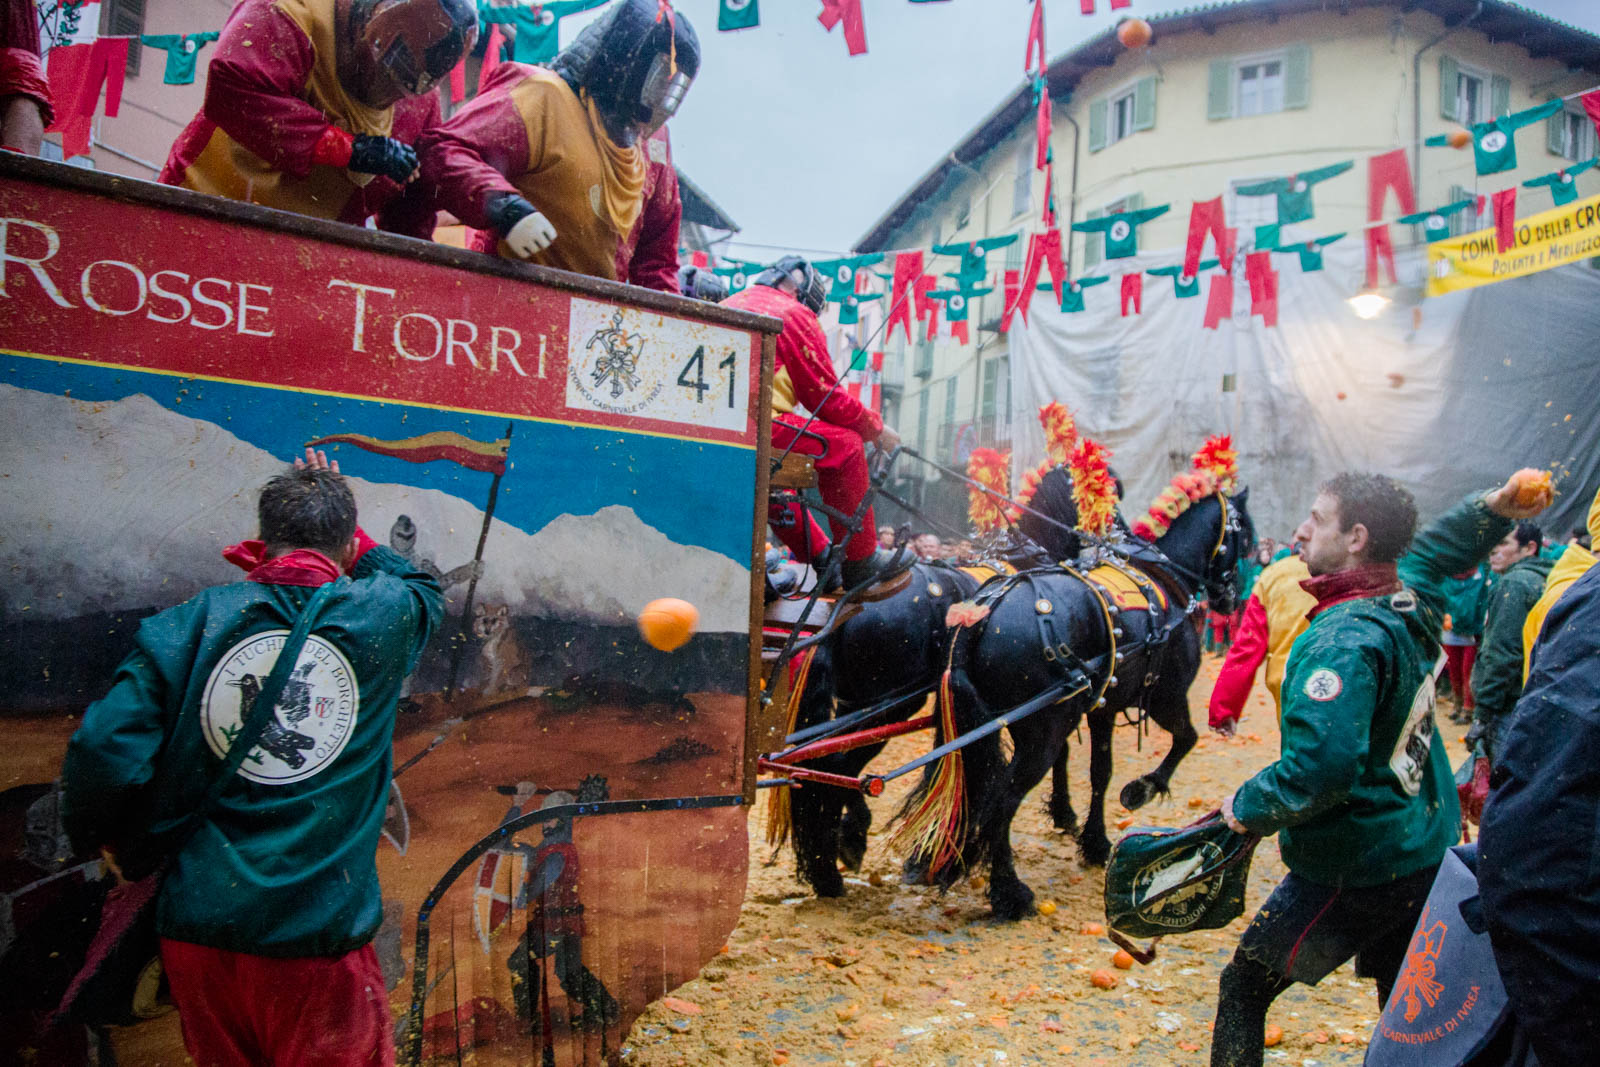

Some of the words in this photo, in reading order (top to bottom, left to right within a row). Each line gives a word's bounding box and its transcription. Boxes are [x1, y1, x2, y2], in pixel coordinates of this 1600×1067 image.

[1462, 225, 1530, 261] COMITO
[1536, 218, 1571, 242] DELLA
[0, 217, 276, 337] ROSSE
[327, 279, 548, 379] TORRI
[676, 343, 737, 409] 41
[592, 399, 638, 415] CARNEVALE
[224, 667, 236, 677] I
[304, 642, 330, 666] DEL
[315, 666, 350, 760] BORGHETTO
[1383, 1027, 1445, 1045] CARNEVALE
[1444, 1017, 1459, 1033] DI
[1457, 985, 1481, 1021] IVREA
